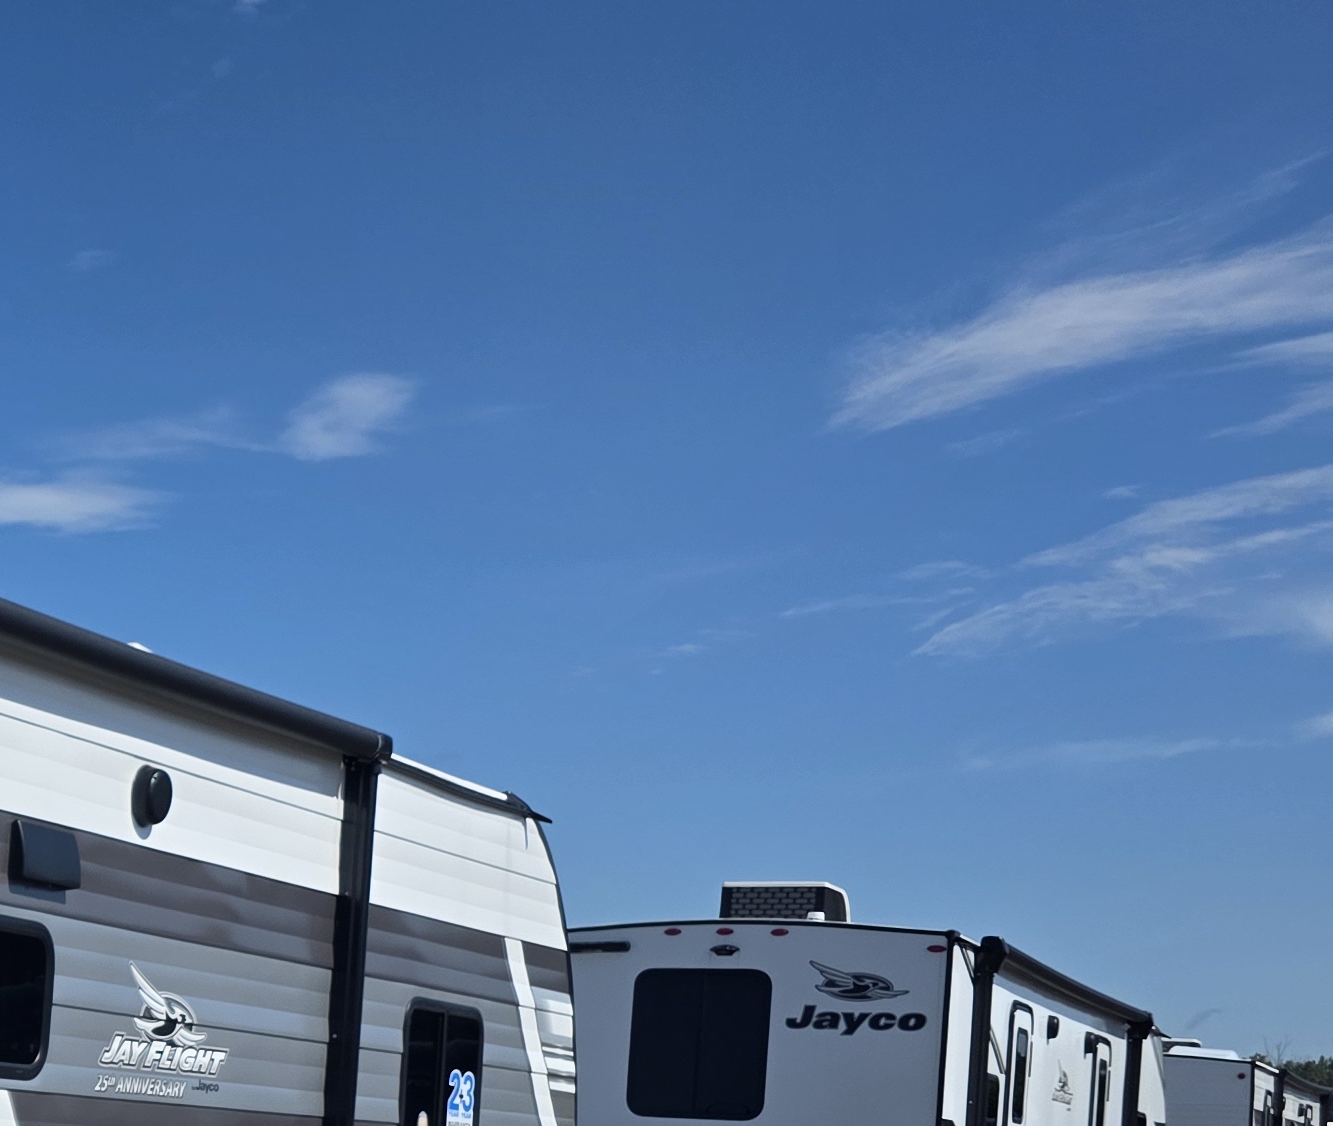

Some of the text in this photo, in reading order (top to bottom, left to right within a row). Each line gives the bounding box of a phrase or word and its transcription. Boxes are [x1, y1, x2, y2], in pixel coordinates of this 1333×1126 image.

[785, 1004, 928, 1036] Jayco
[98, 1032, 228, 1076] JAY FLIGHT
[115, 1077, 187, 1098] ANNIVERSARY
